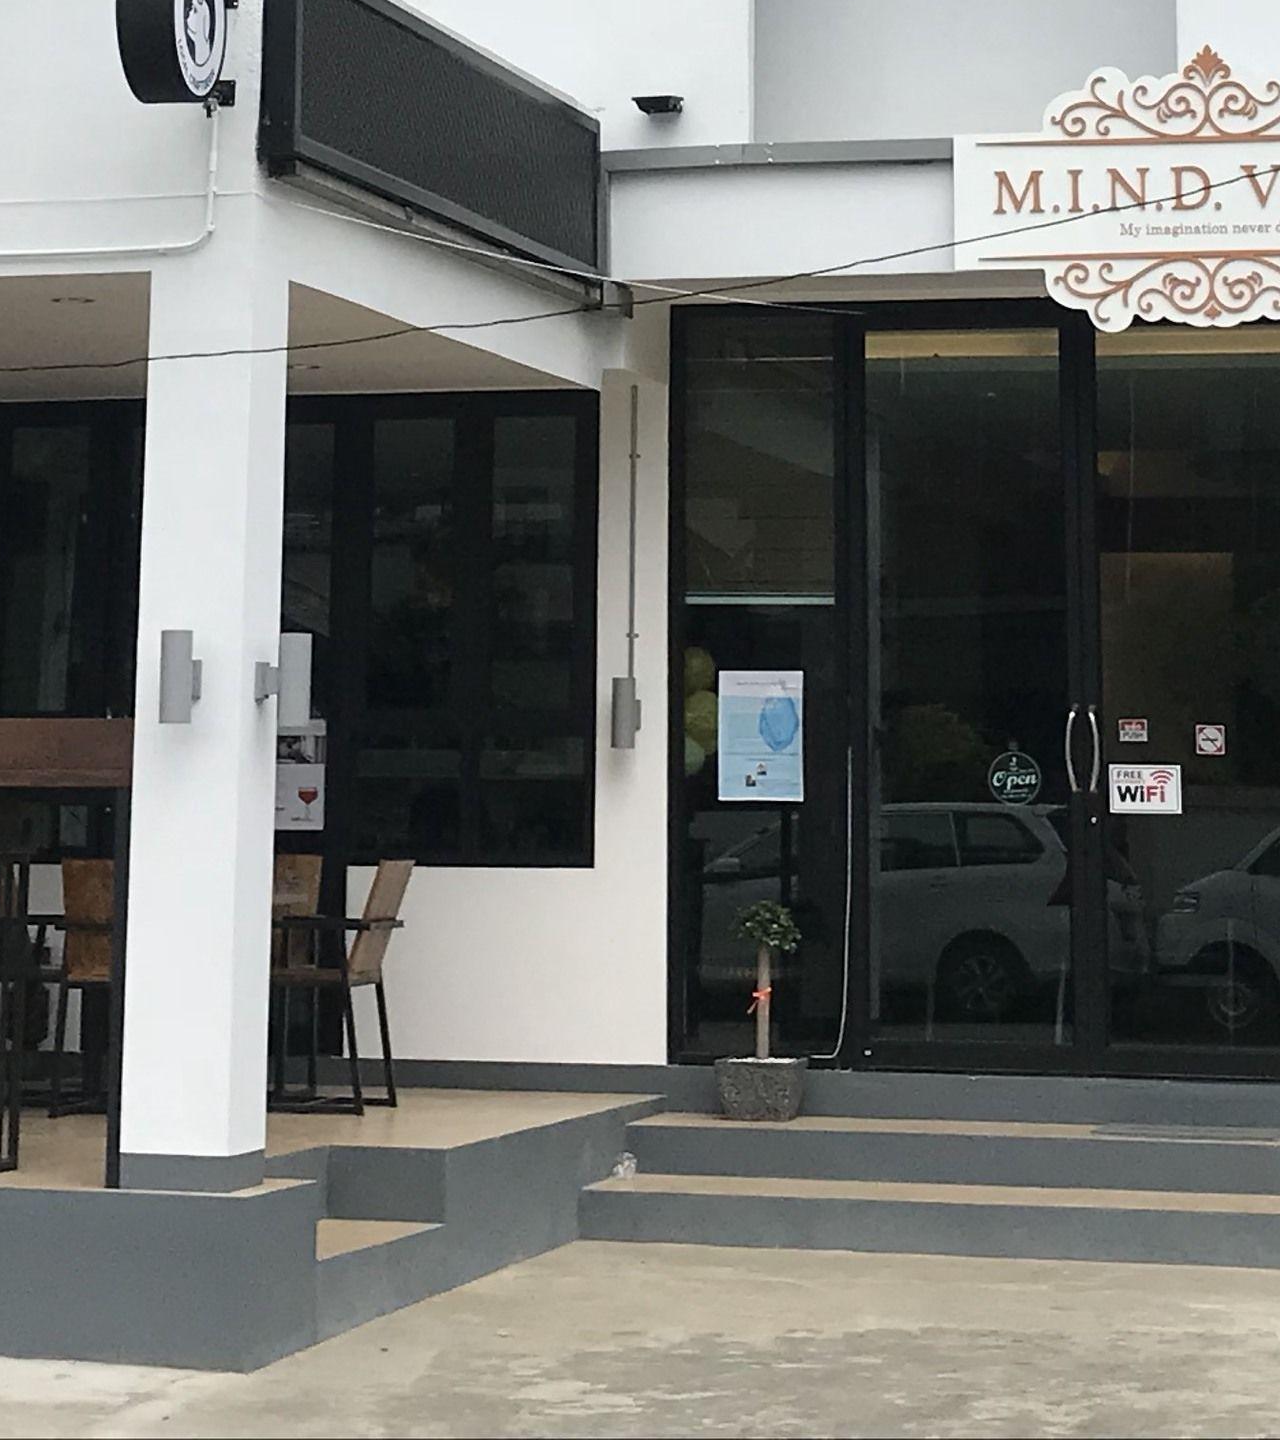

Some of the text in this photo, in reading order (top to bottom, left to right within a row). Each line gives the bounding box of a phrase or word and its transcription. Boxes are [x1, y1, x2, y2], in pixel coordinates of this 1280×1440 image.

[993, 165, 1222, 214] M.I.N.D.
[1120, 223, 1141, 237] My
[1146, 222, 1228, 237] imagination
[1232, 222, 1271, 234] never
[992, 771, 1038, 790] Open
[1116, 771, 1142, 779] FREE
[1117, 785, 1166, 802] WiFi
